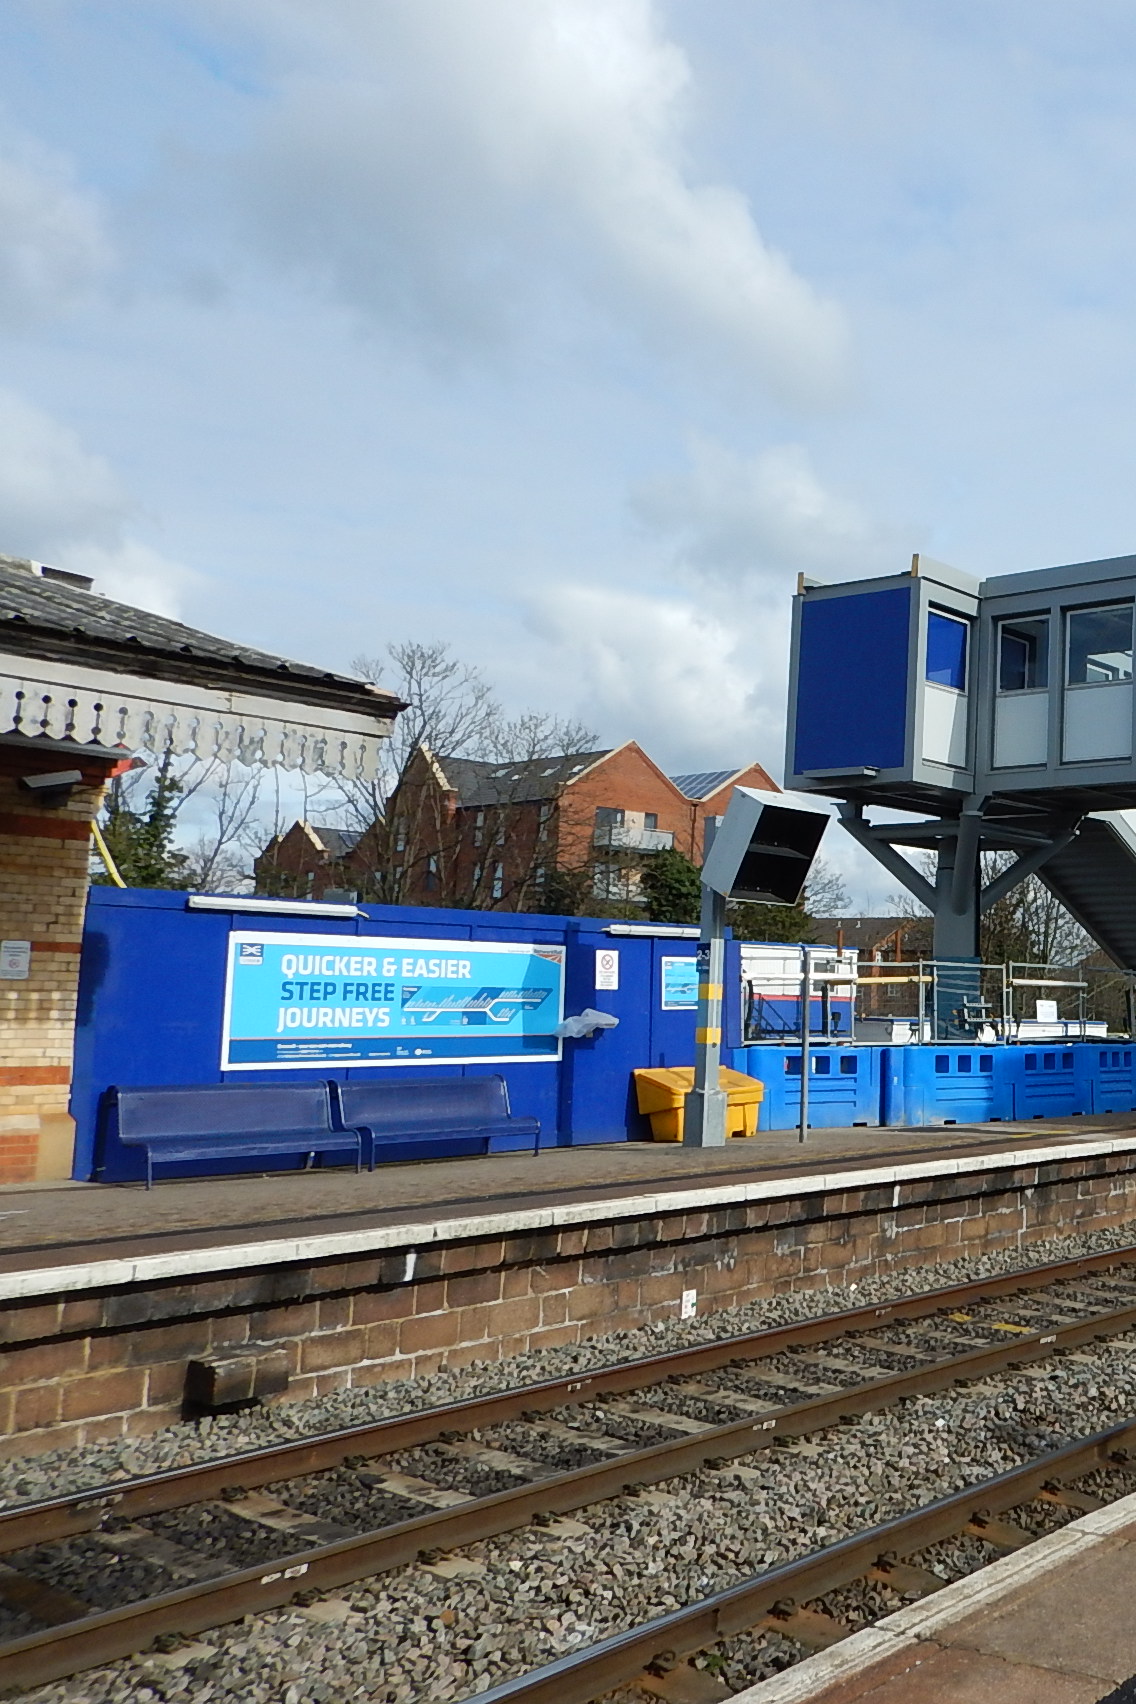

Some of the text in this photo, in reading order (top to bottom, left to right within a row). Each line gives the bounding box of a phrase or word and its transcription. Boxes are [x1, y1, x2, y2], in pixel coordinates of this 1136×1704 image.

[281, 953, 472, 979] QUICKER & EASIER
[280, 980, 337, 1001] STEP
[342, 981, 395, 1002] FREE
[276, 1006, 391, 1033] JOURNEYS
